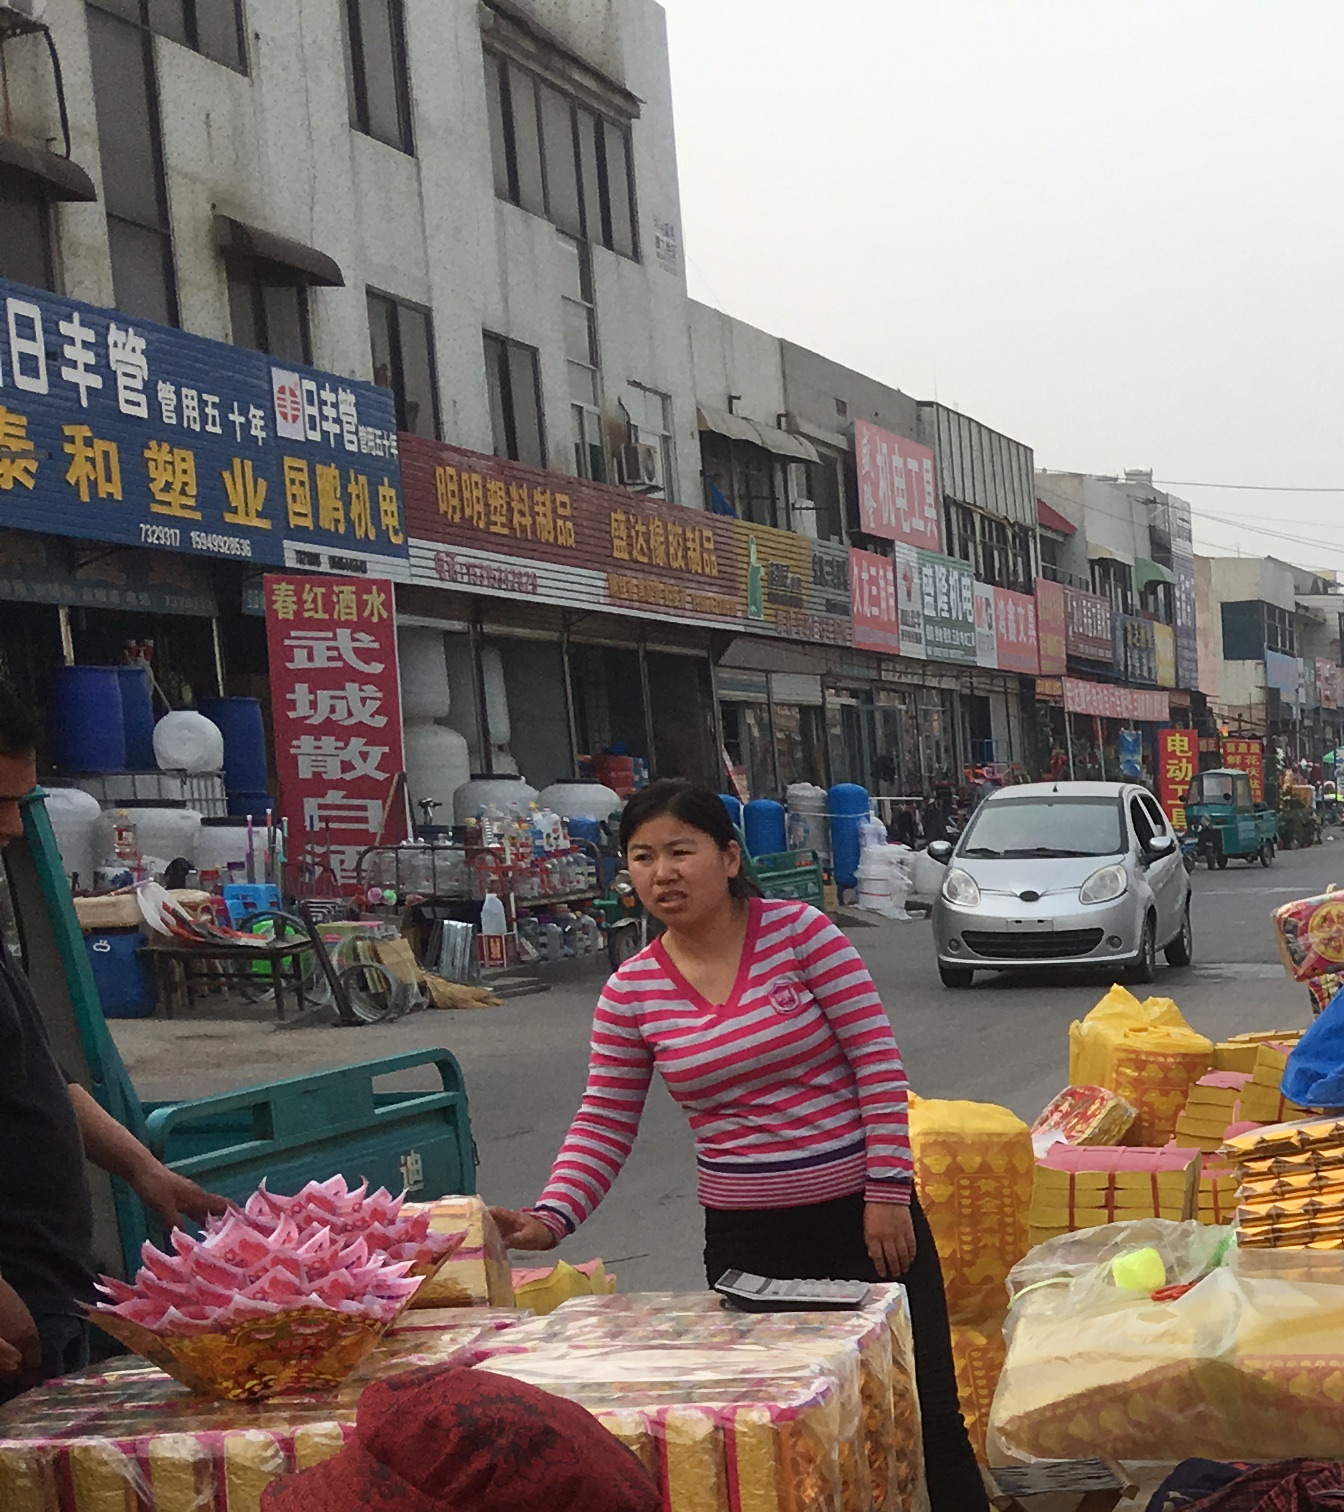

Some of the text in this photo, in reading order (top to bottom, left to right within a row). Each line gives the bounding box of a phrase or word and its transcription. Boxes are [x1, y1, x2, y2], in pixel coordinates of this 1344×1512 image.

[6, 297, 149, 419] 日丰管
[157, 380, 267, 446] 管用五十年
[301, 378, 358, 452] 日丰管
[435, 466, 576, 548] 明明塑料制品
[271, 583, 388, 622] 春红酒水
[283, 628, 393, 895] 武城散白酒
[1166, 733, 1193, 833] 电动工具
